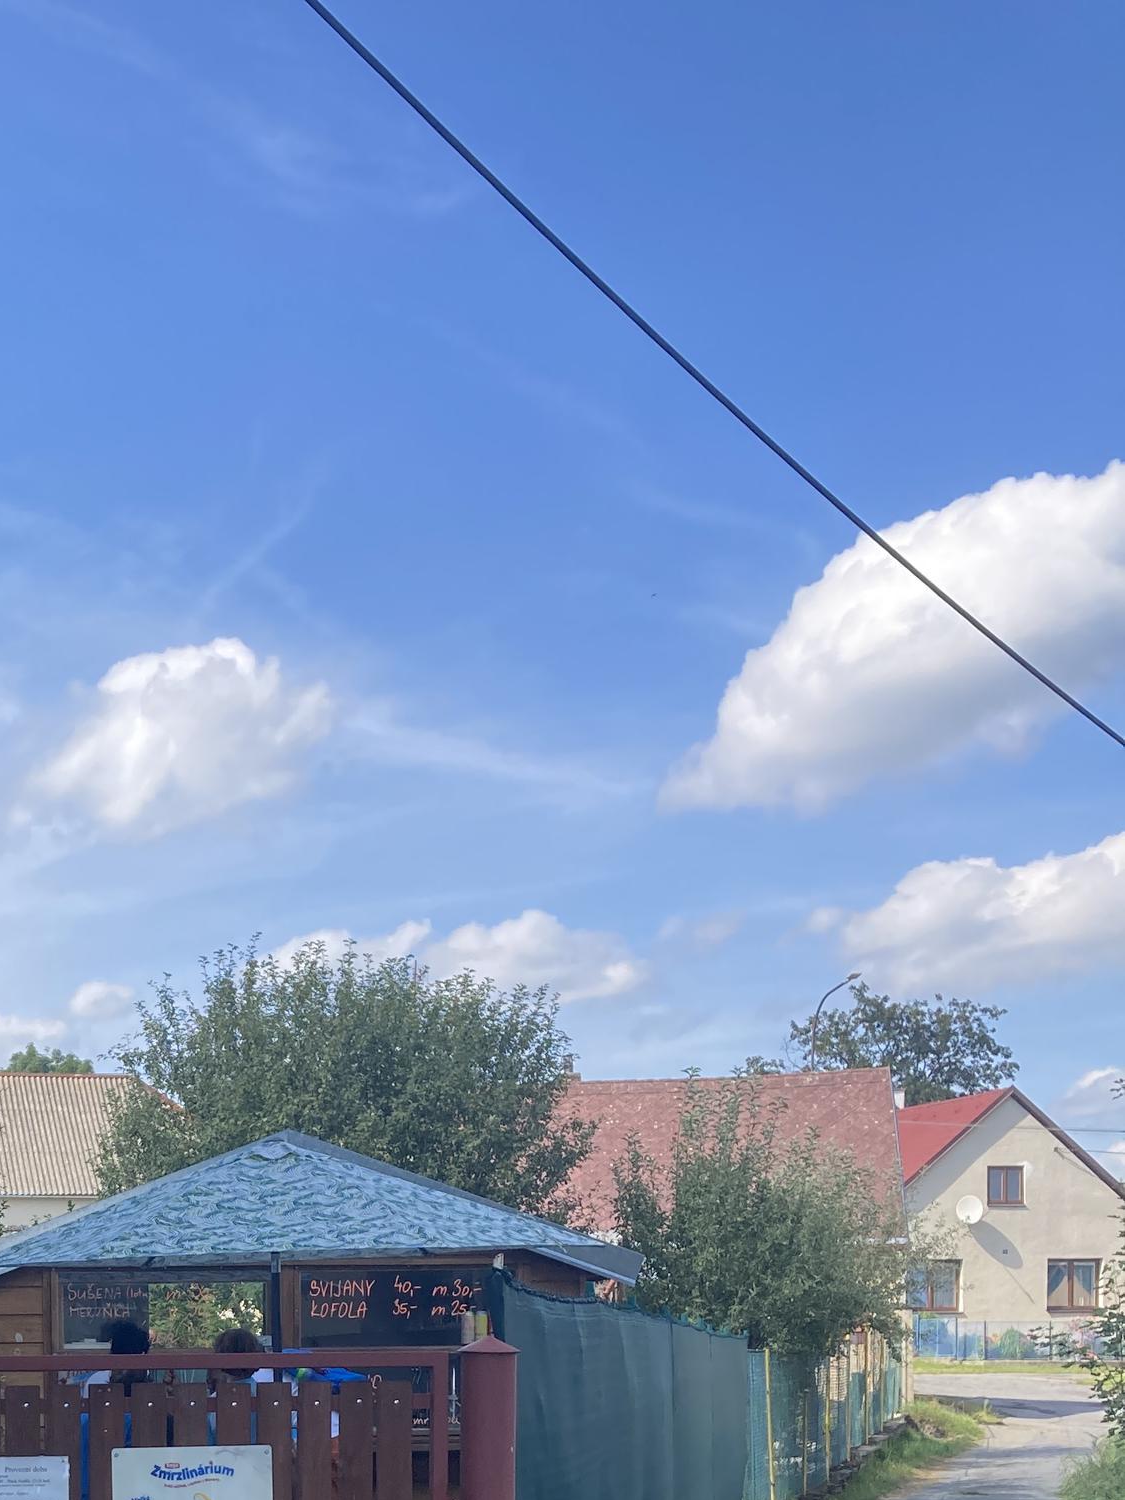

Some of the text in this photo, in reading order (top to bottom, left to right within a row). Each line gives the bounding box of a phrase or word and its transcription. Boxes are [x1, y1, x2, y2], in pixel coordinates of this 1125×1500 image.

[309, 1279, 376, 1298] SVIJANY
[393, 1275, 422, 1297] 40,-
[310, 1299, 368, 1319] KOFOLA
[150, 1461, 235, 1481] Zmrzlinárium
